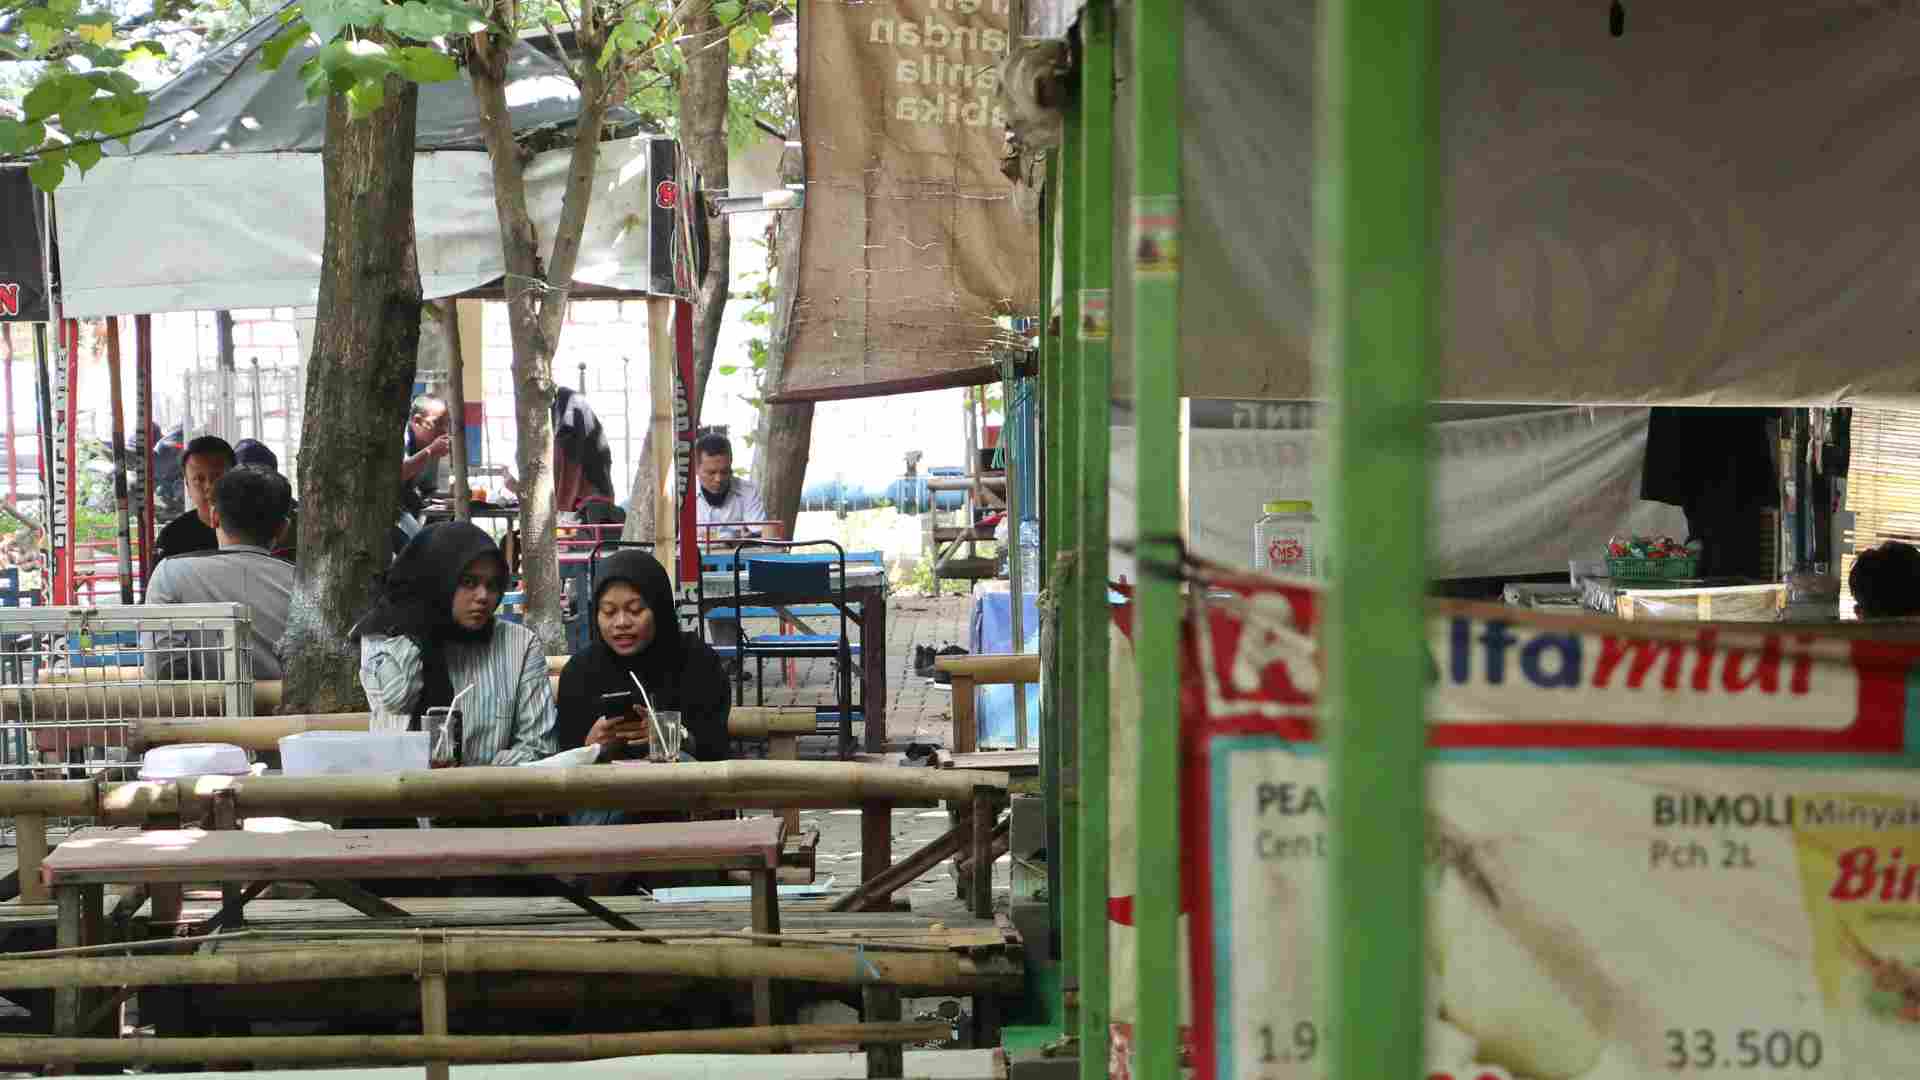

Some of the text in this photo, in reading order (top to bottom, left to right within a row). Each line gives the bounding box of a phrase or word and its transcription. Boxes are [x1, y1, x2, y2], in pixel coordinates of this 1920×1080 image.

[1427, 616, 1817, 694] lfamidi
[1256, 783, 1327, 817] PEA
[1653, 793, 1795, 828] BIMOLI
[1256, 830, 1328, 860] Cent
[1257, 1020, 1324, 1062] 1.9
[1665, 1029, 1823, 1069] 33.500
